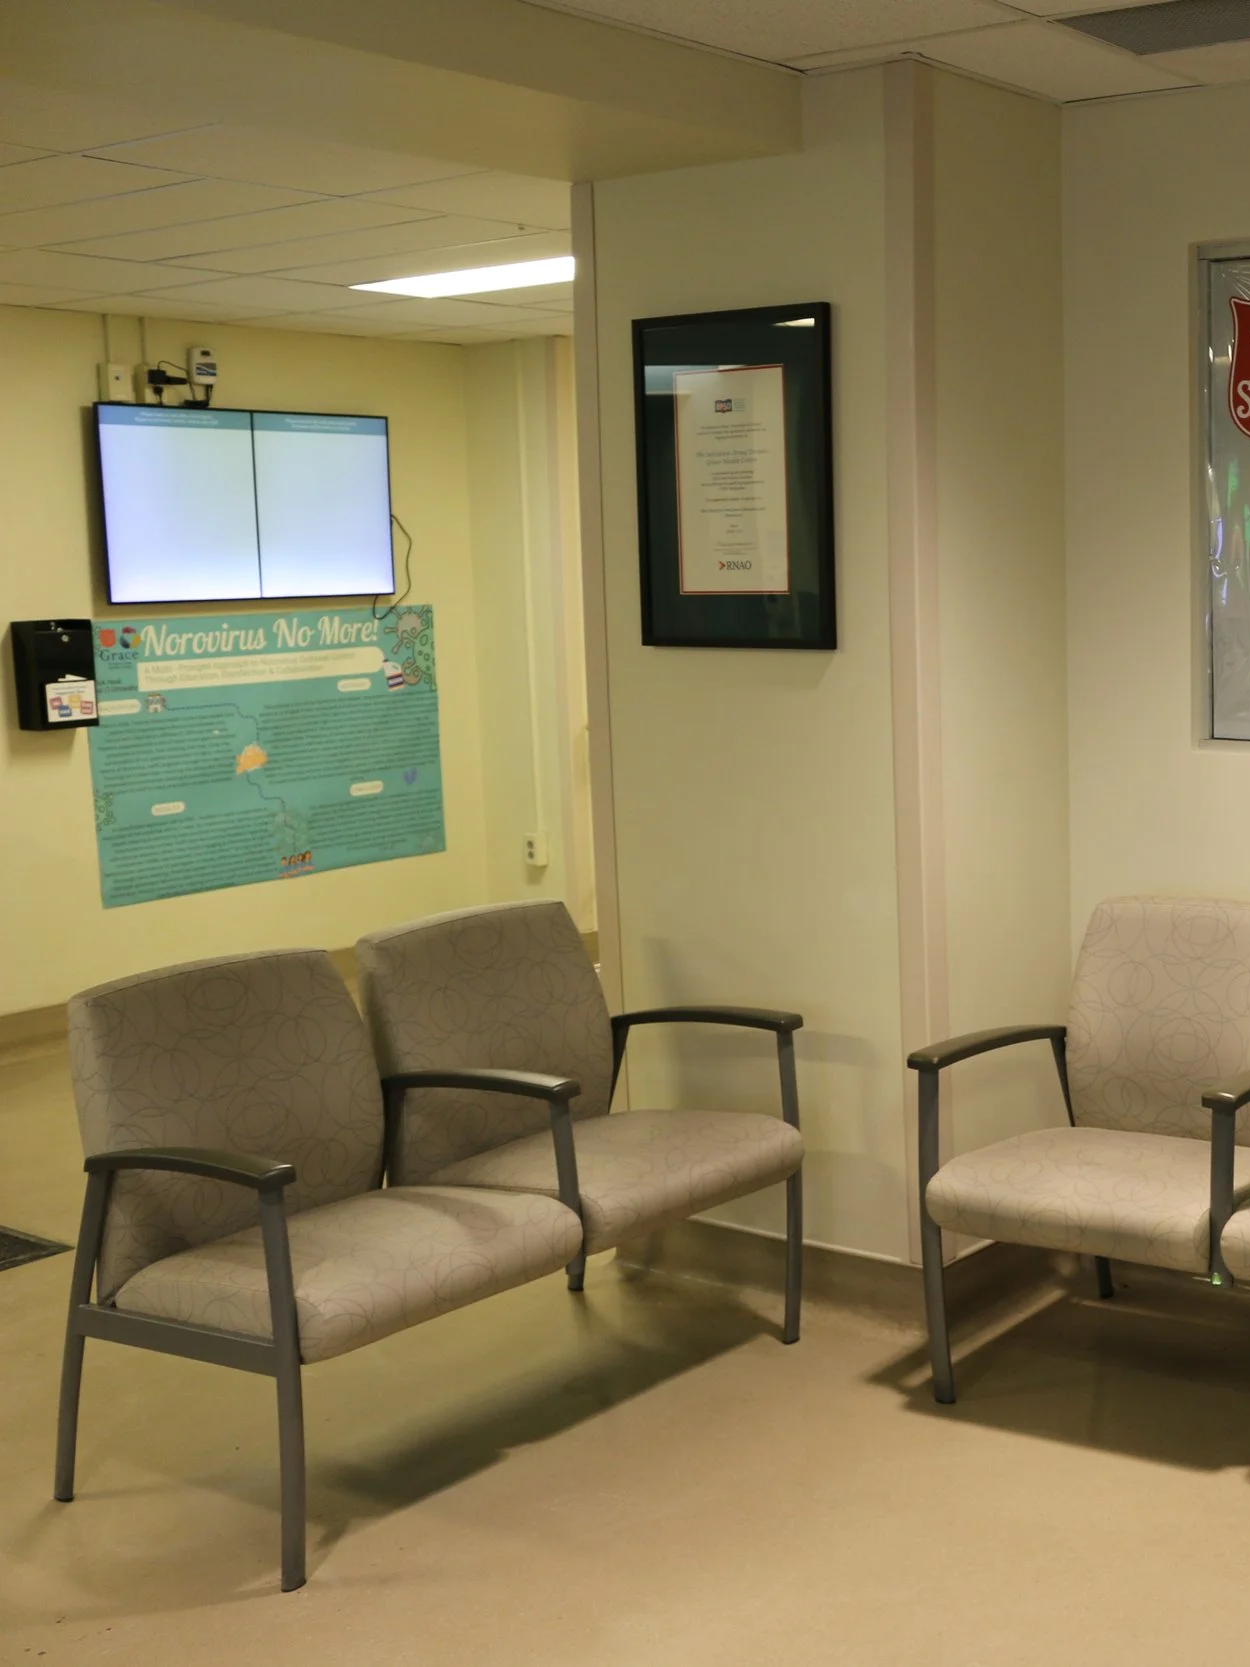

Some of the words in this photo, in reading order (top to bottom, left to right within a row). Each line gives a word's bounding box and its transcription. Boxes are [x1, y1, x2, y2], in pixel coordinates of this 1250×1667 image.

[727, 560, 751, 570] RNAO
[141, 623, 267, 657] Norovirus
[273, 617, 315, 648] No
[317, 614, 380, 645] More!
[99, 649, 139, 661] Grace
